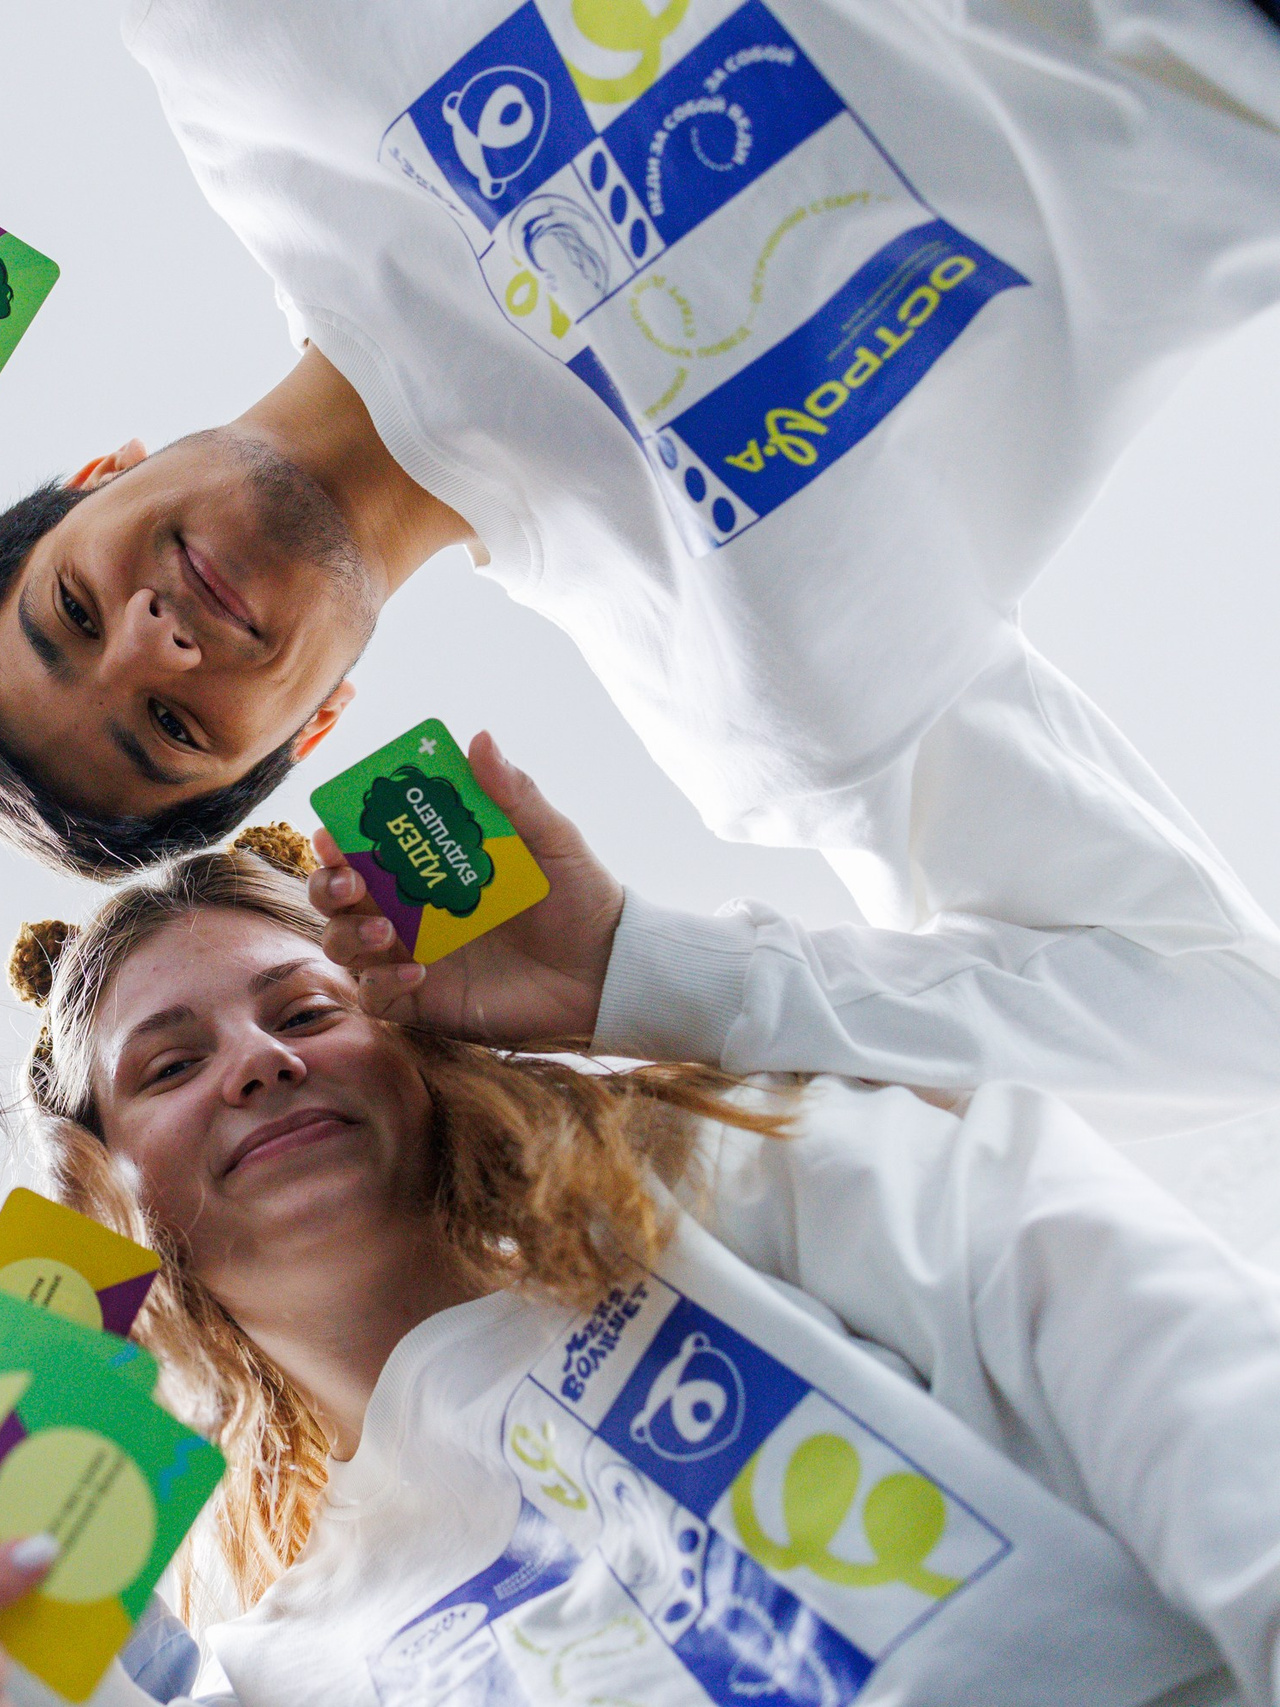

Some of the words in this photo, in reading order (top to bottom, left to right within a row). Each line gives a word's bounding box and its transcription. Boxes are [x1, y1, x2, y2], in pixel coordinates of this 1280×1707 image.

[386, 813, 448, 889] ИДЕЯ
[406, 787, 479, 887] БУДУЩЕГО
[561, 1281, 648, 1403] ВОЛНУЕТ
